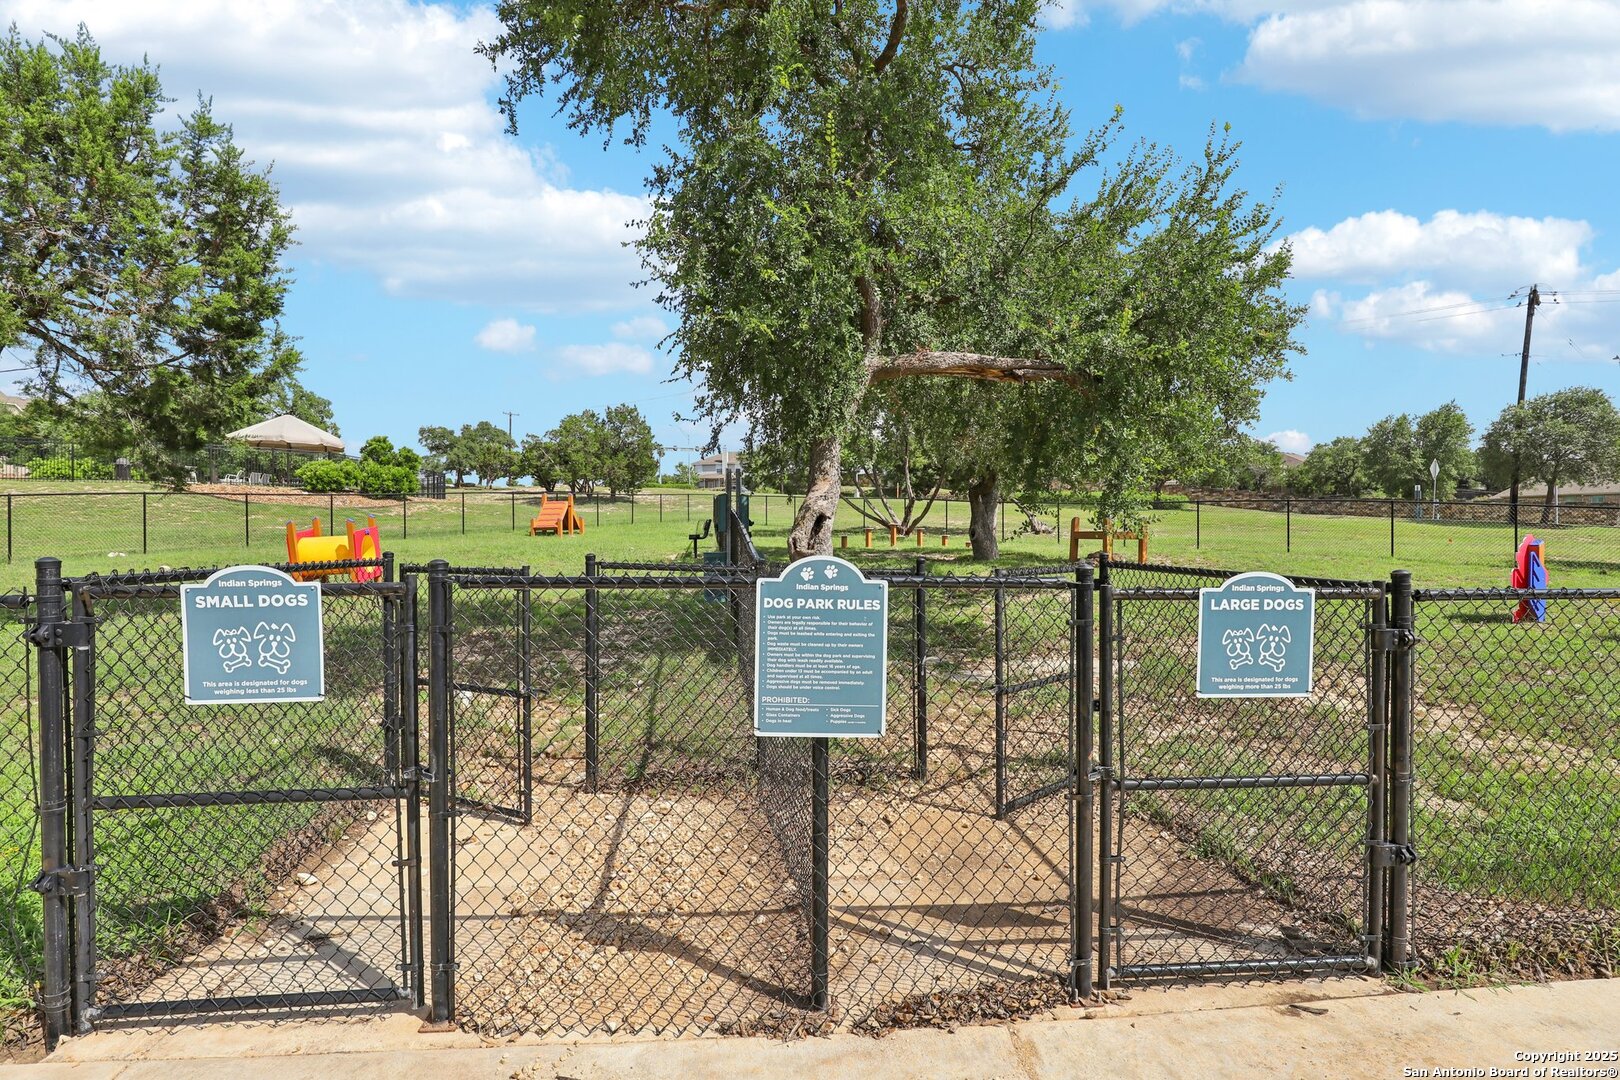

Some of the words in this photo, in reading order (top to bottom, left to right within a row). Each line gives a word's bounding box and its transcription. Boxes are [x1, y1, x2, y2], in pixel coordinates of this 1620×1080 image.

[248, 579, 282, 587] Springs
[196, 595, 253, 608] SMALL
[258, 594, 308, 607] DOGS
[764, 598, 793, 608] DOG
[797, 599, 834, 609] PARK
[838, 600, 880, 610] RULES
[1211, 599, 1259, 610] LARGE
[1264, 599, 1304, 610] DOGS
